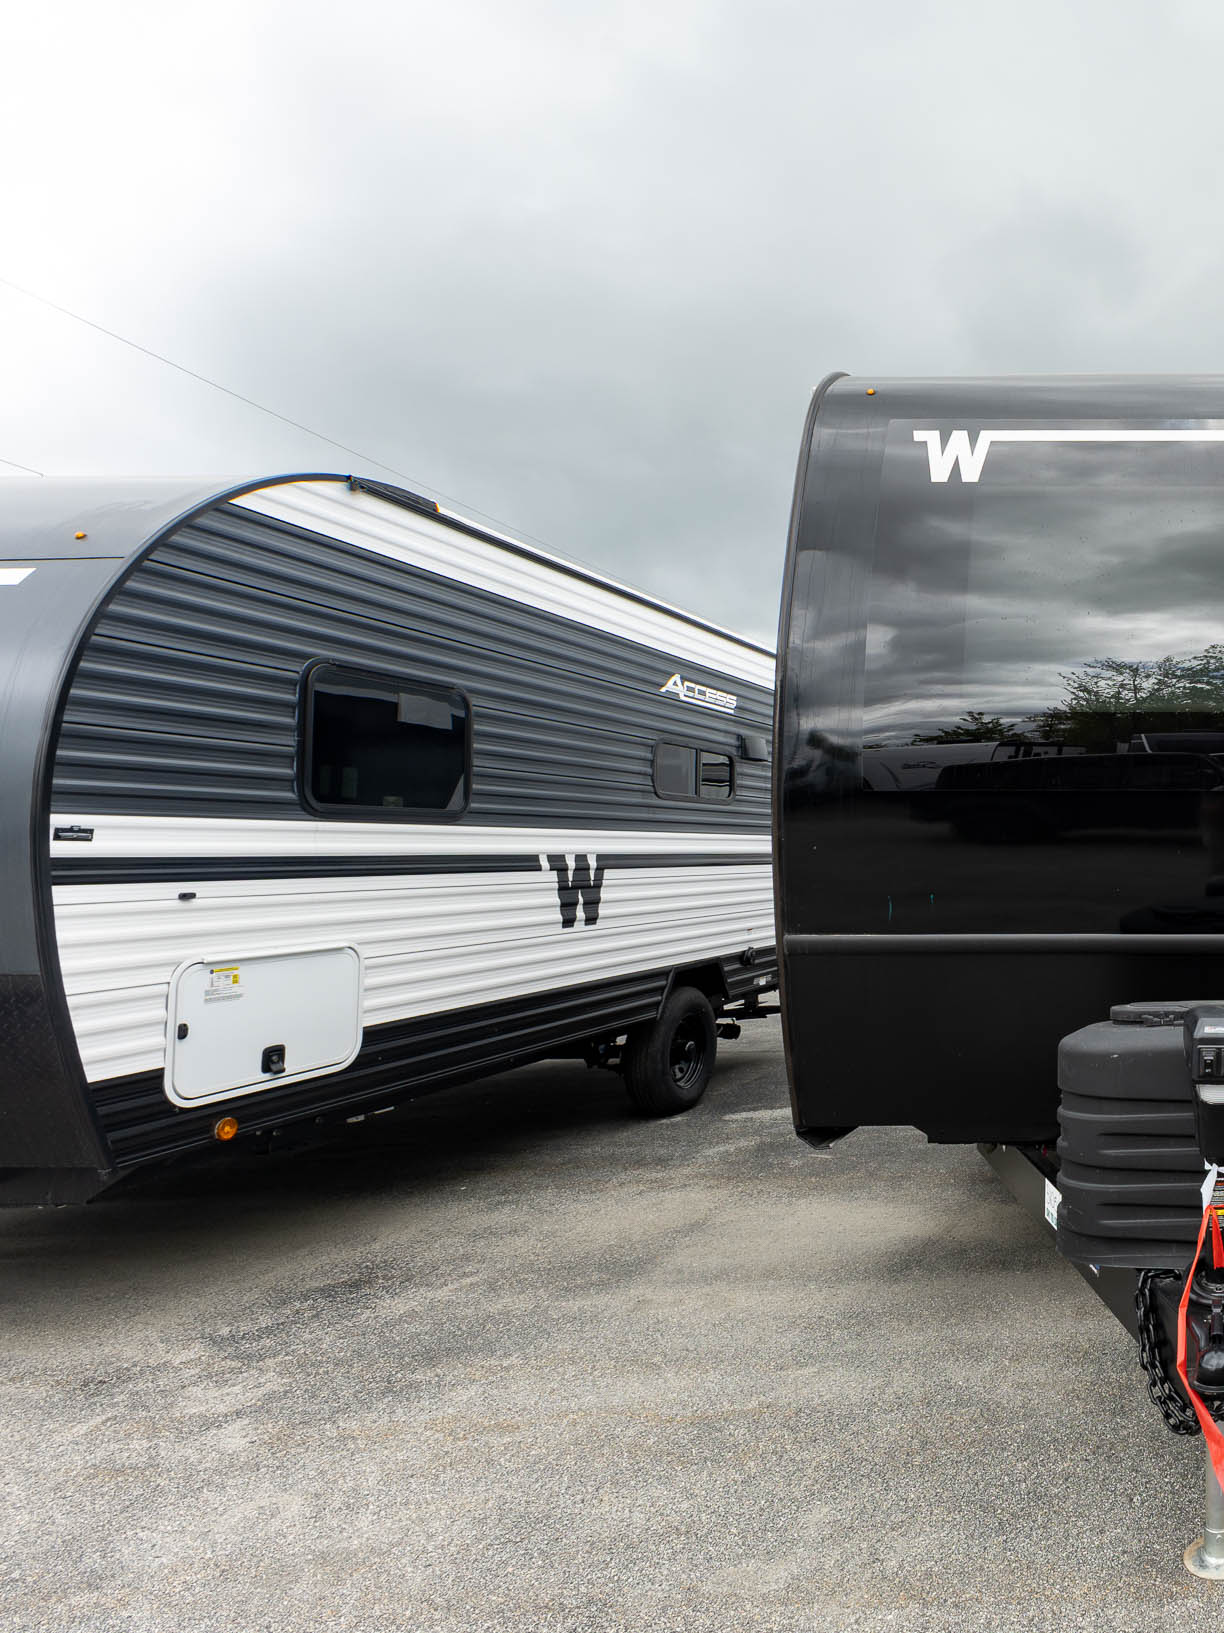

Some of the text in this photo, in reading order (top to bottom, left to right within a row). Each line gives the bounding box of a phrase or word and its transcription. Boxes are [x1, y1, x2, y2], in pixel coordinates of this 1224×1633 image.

[912, 430, 993, 483] W
[659, 673, 737, 712] ACCESS
[546, 854, 605, 928] W
